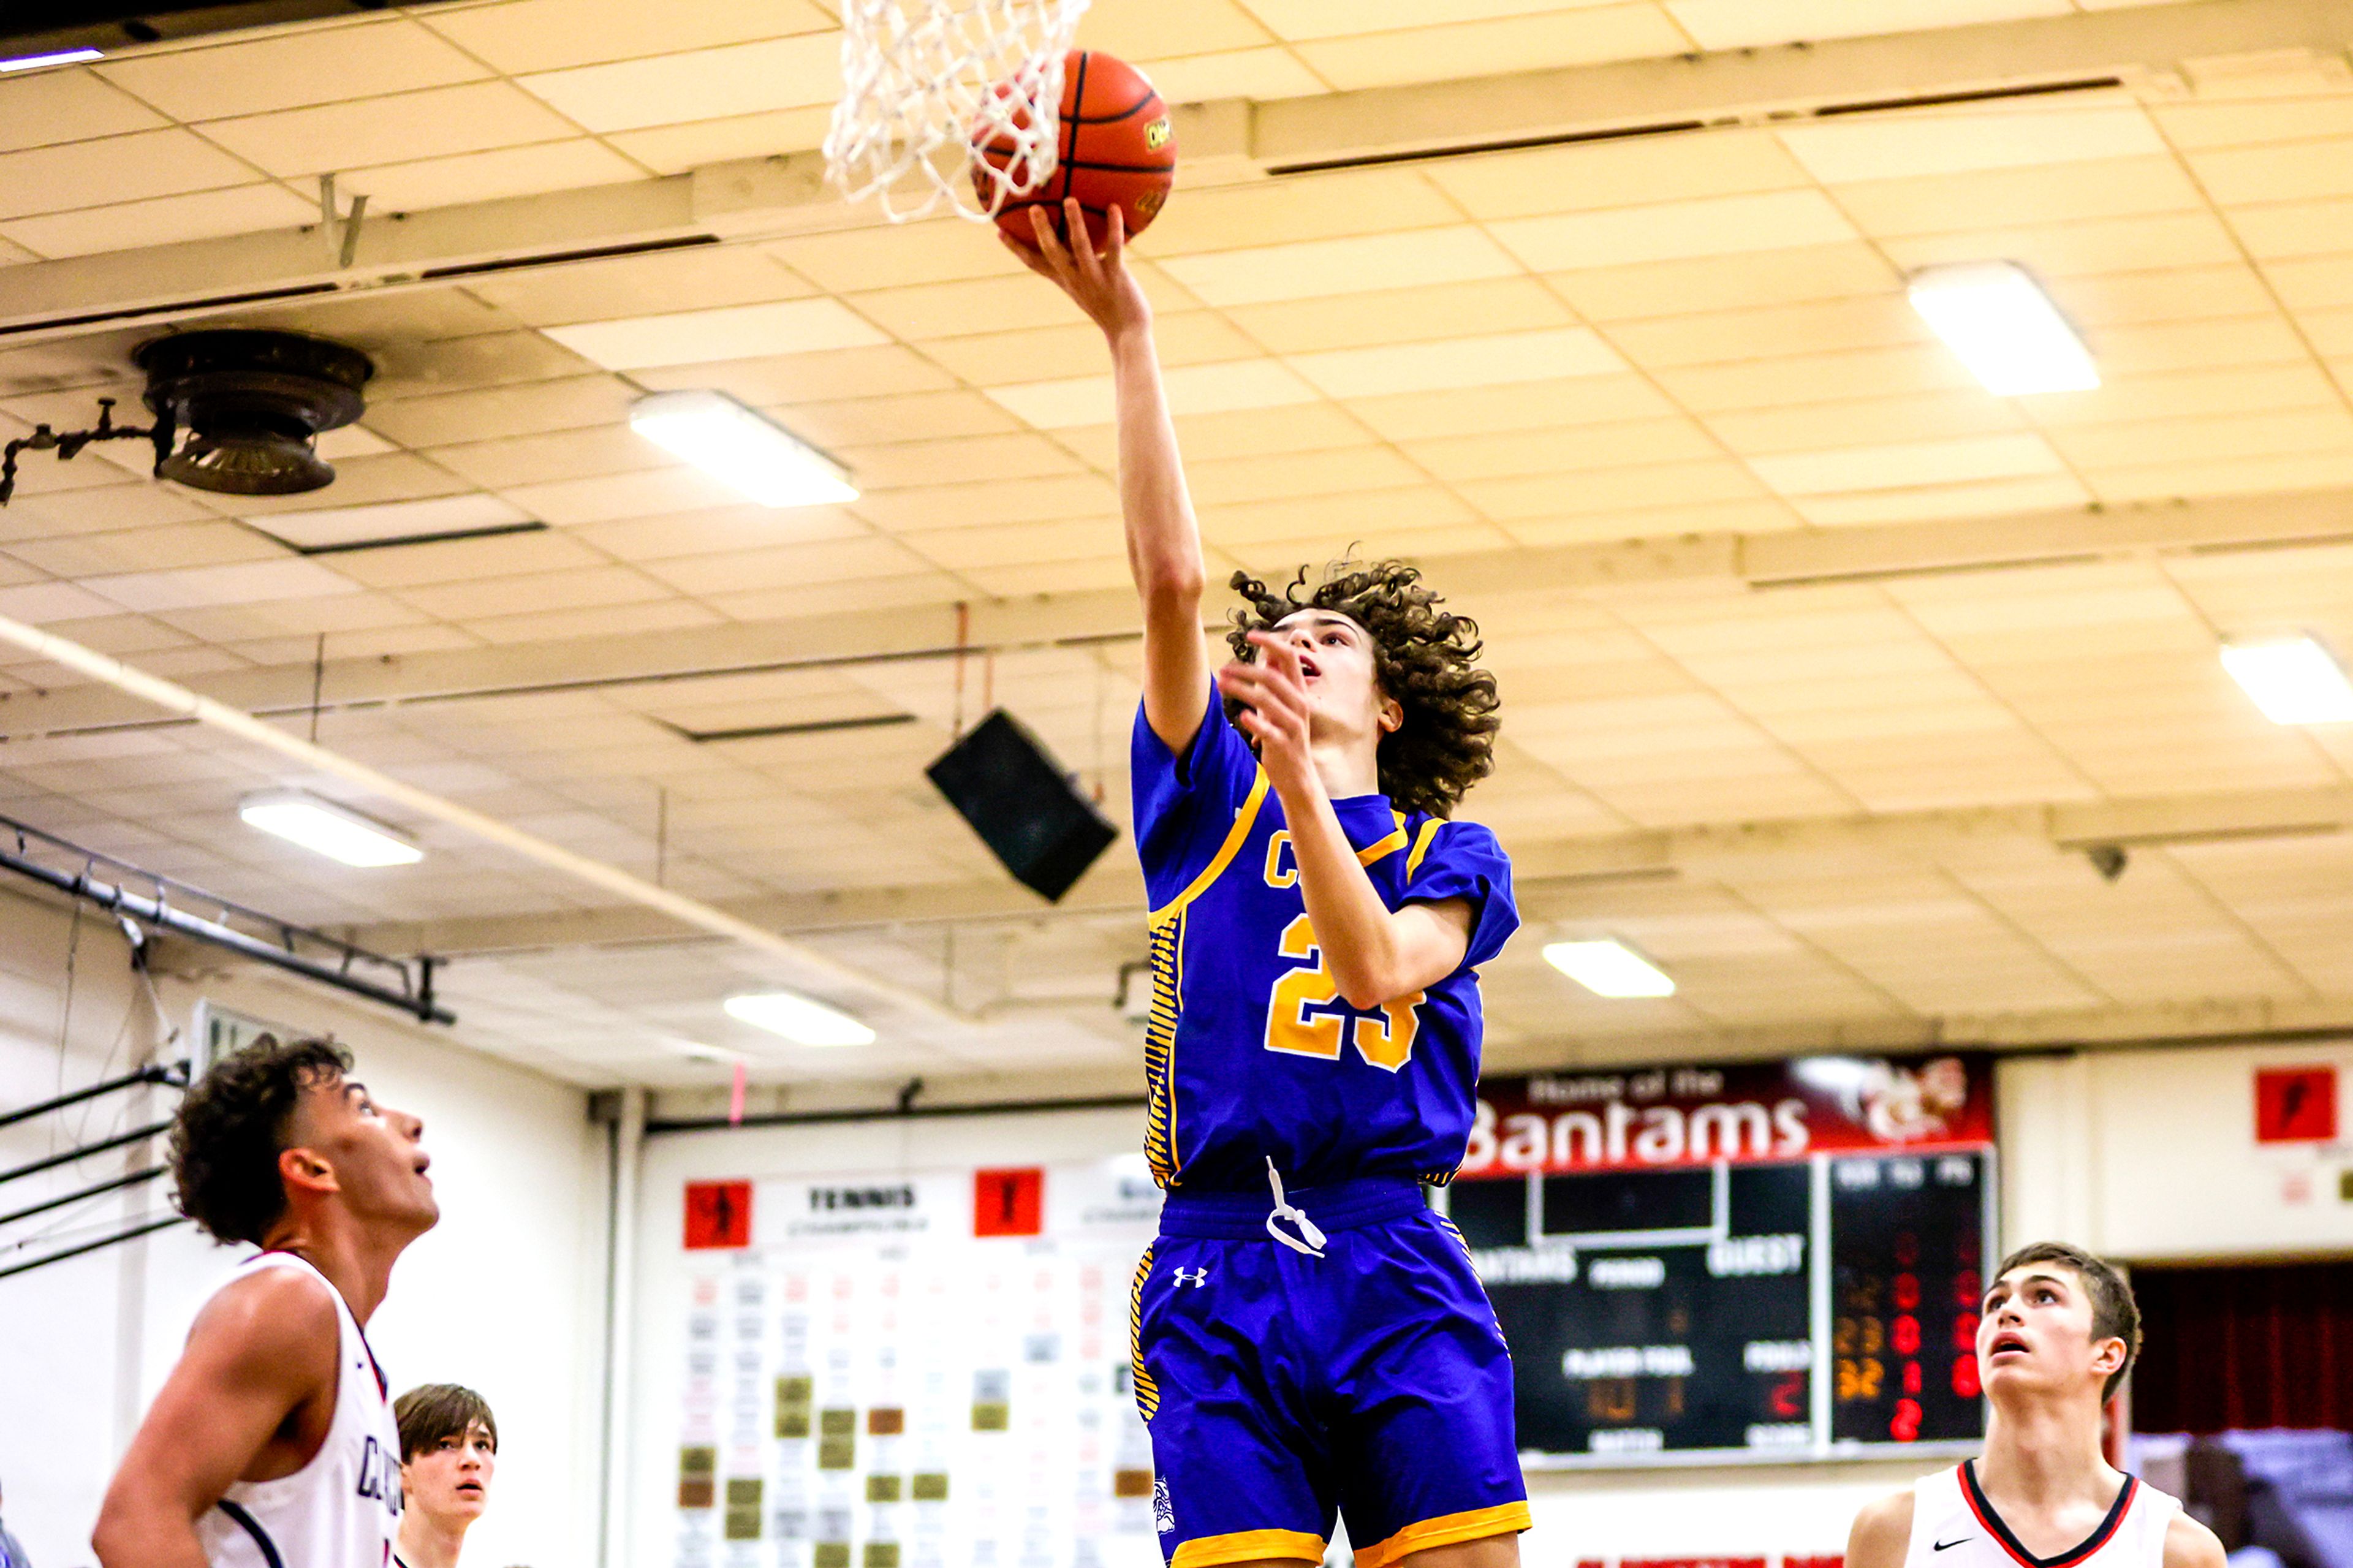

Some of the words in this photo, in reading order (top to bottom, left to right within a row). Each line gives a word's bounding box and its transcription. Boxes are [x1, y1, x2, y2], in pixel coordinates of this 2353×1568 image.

[1529, 1075, 1625, 1102] Home
[1630, 1071, 1665, 1099] of
[1671, 1069, 1724, 1098] the
[1463, 1099, 1809, 1171] Bantams
[809, 1184, 915, 1211] TENNIS
